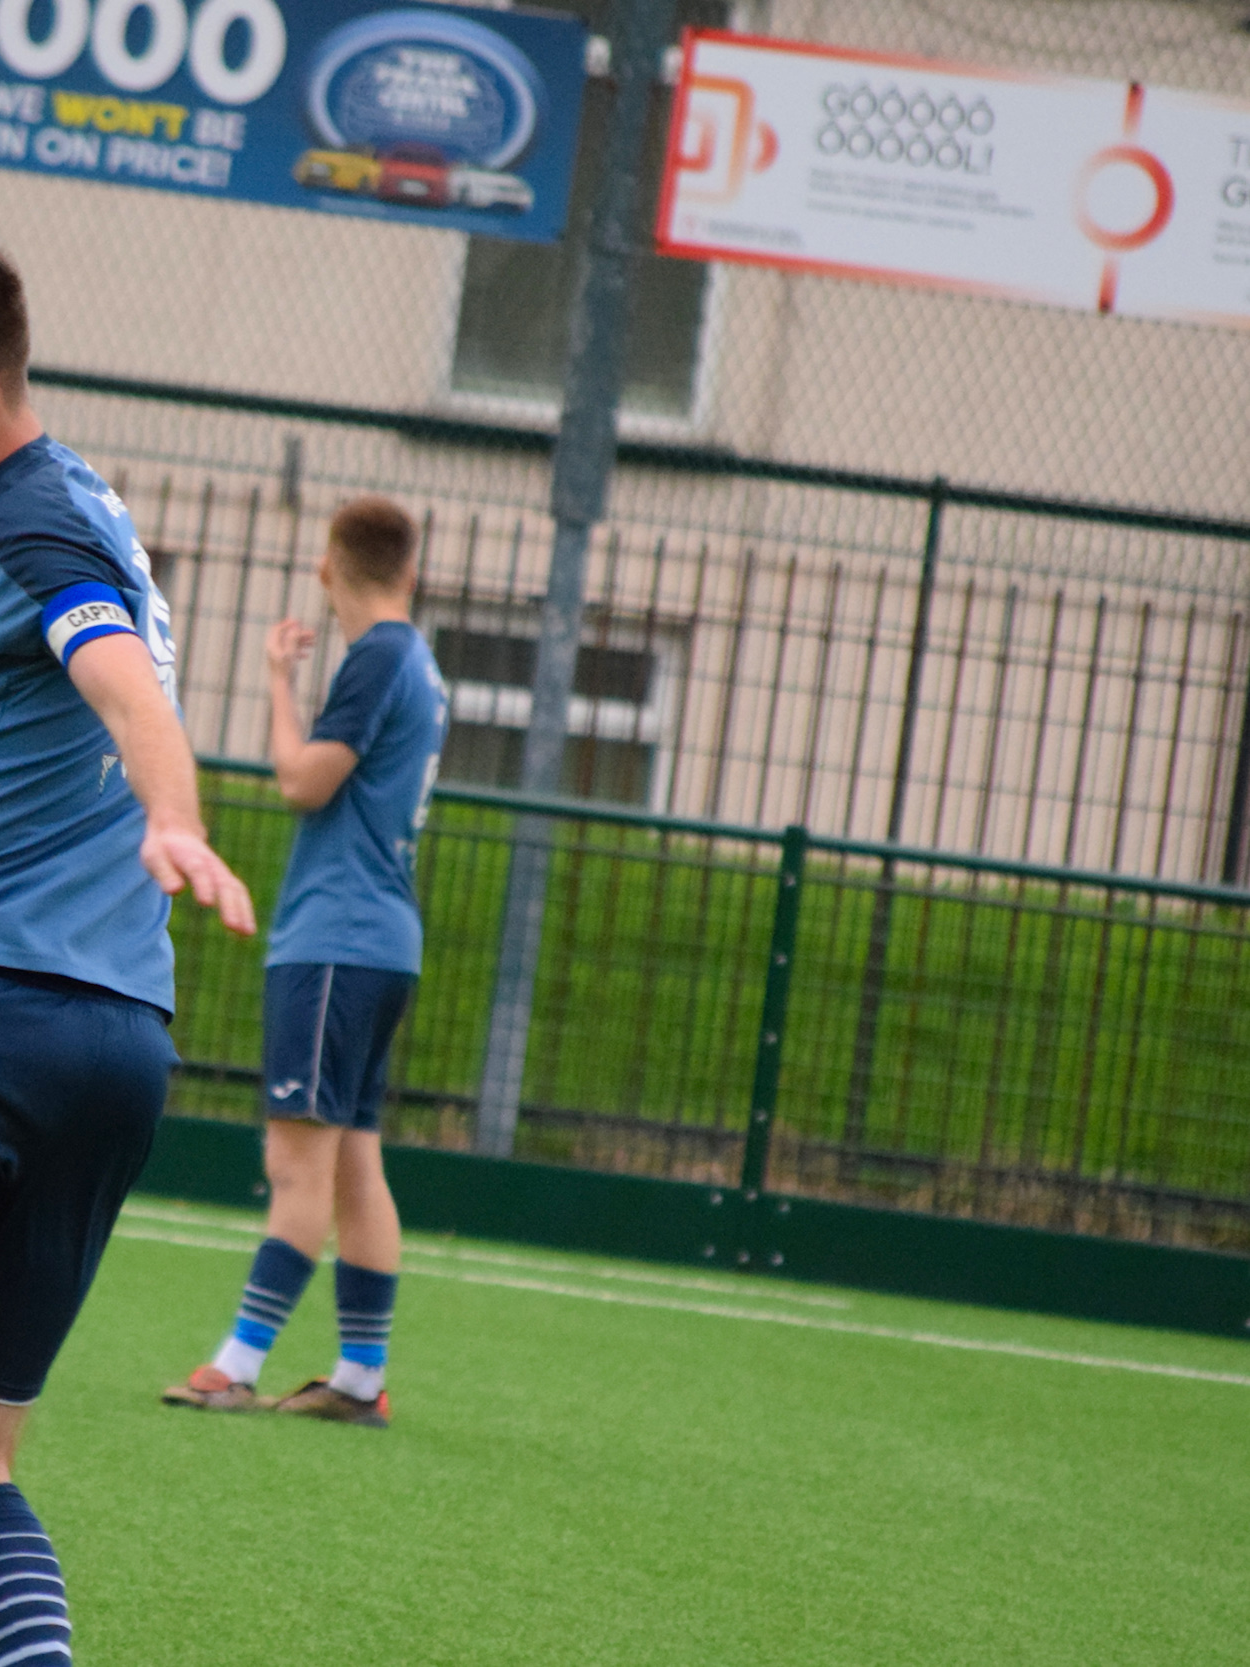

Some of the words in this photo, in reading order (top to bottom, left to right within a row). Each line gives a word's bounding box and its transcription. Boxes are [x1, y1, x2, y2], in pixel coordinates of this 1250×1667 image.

[51, 88, 188, 141] WON'T
[192, 106, 247, 151] BE
[33, 125, 101, 170] ON
[104, 135, 233, 188] PRICE!
